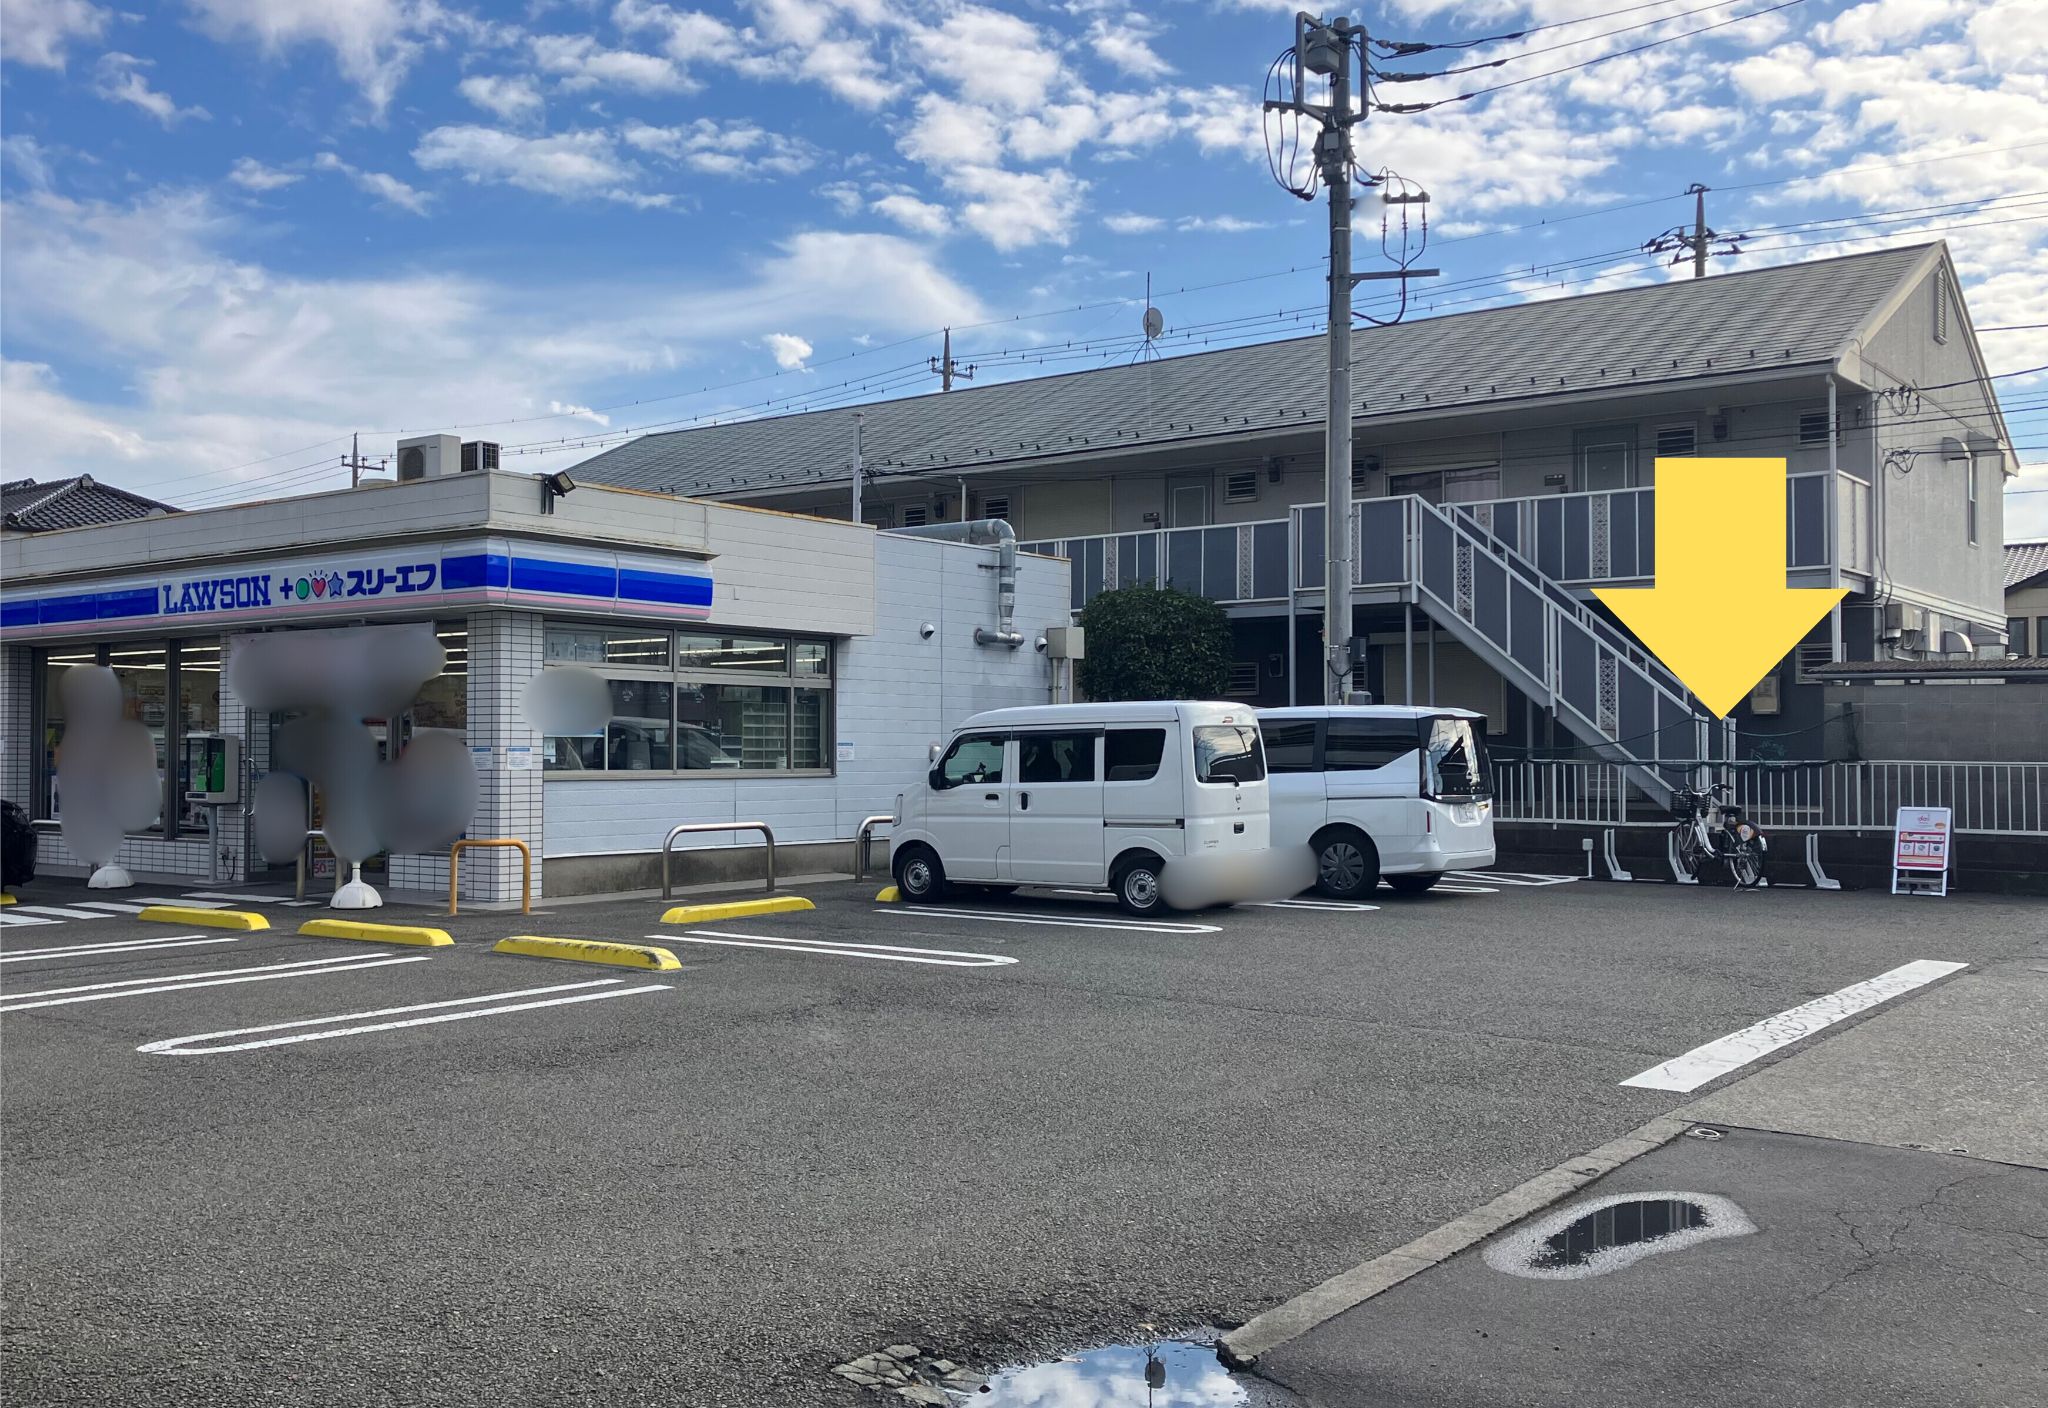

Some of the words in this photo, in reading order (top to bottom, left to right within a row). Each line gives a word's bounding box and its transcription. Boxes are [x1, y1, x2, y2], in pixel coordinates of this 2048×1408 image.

[163, 575, 271, 613] LAWSON
[347, 563, 437, 597] スリーエフ
